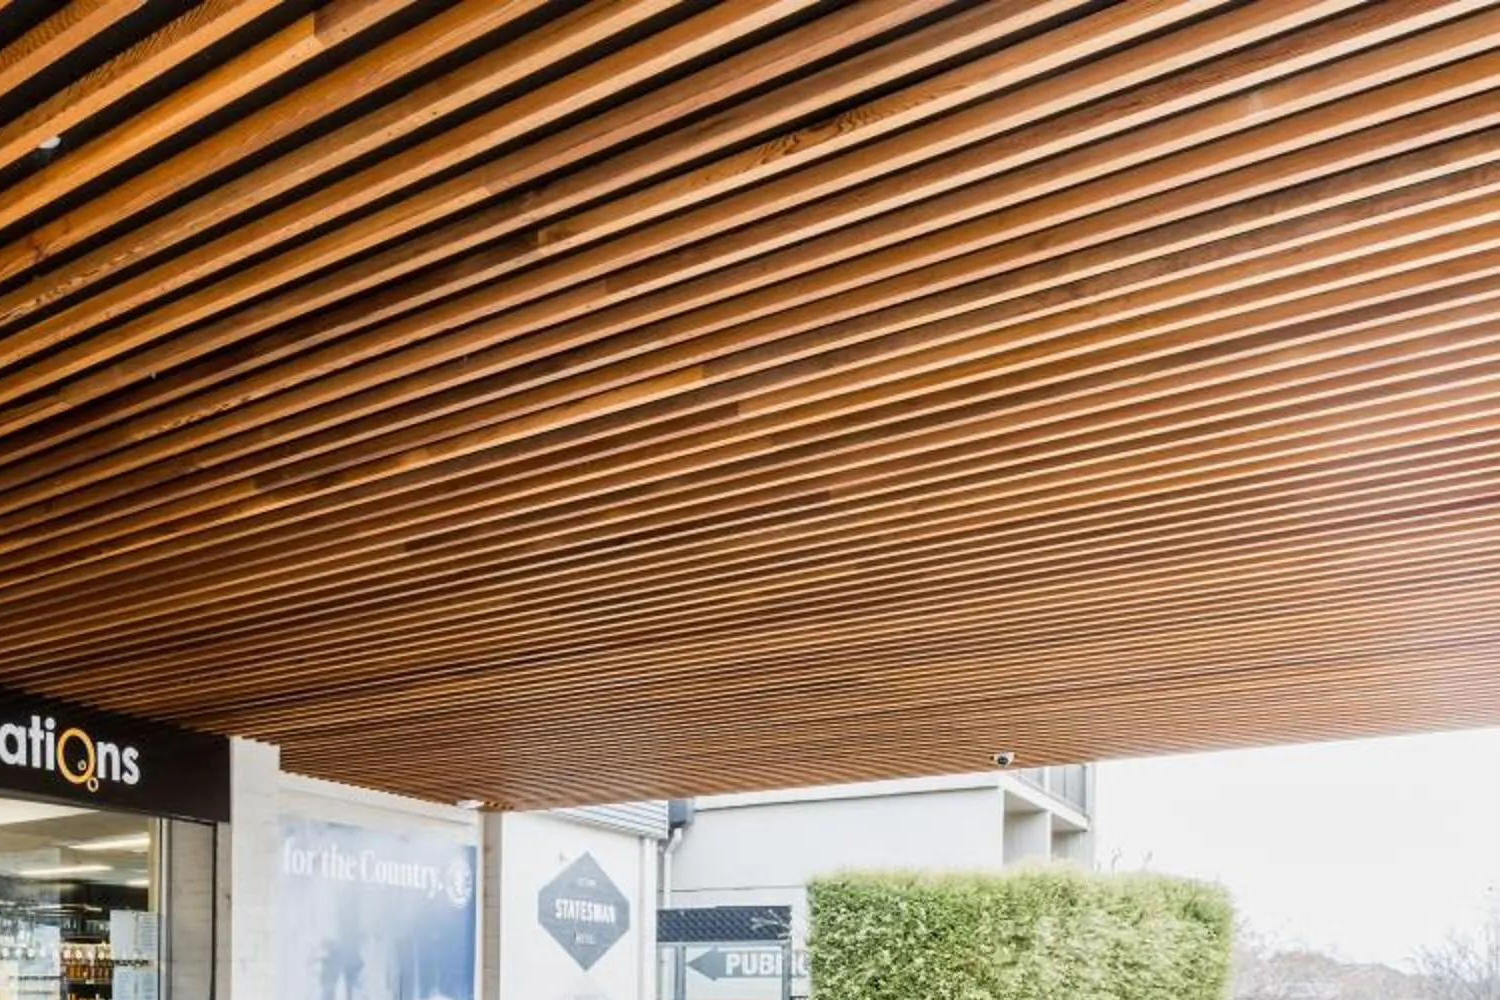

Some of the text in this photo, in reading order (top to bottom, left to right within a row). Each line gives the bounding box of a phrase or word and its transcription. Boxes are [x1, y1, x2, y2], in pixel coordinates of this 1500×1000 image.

[320, 844, 357, 881] the
[359, 849, 443, 899] Country.
[555, 898, 616, 924] STATESMAN
